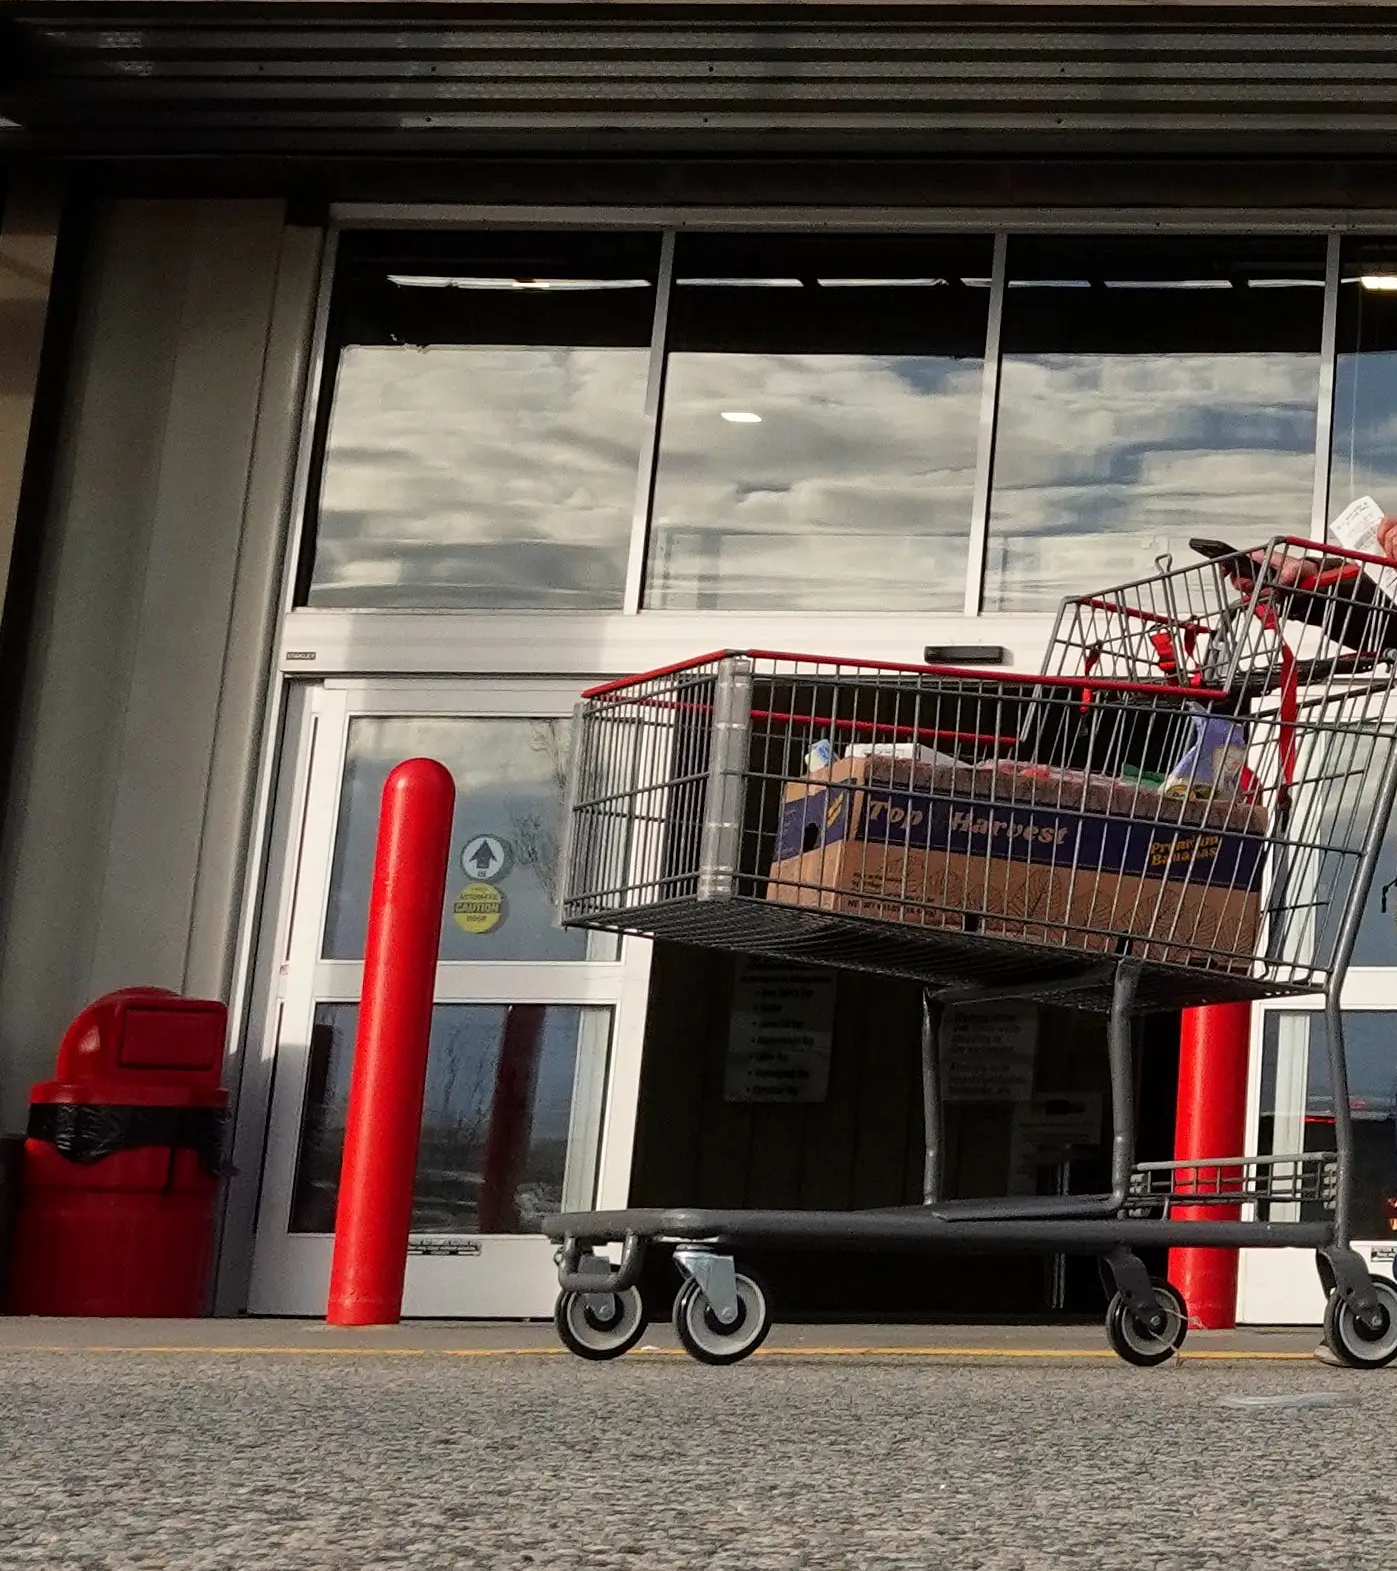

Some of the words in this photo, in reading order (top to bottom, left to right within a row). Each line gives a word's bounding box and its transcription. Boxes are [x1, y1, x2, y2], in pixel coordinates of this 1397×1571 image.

[870, 800, 923, 829] Top
[952, 811, 1068, 845] Harvest
[455, 902, 500, 913] CAUTION
